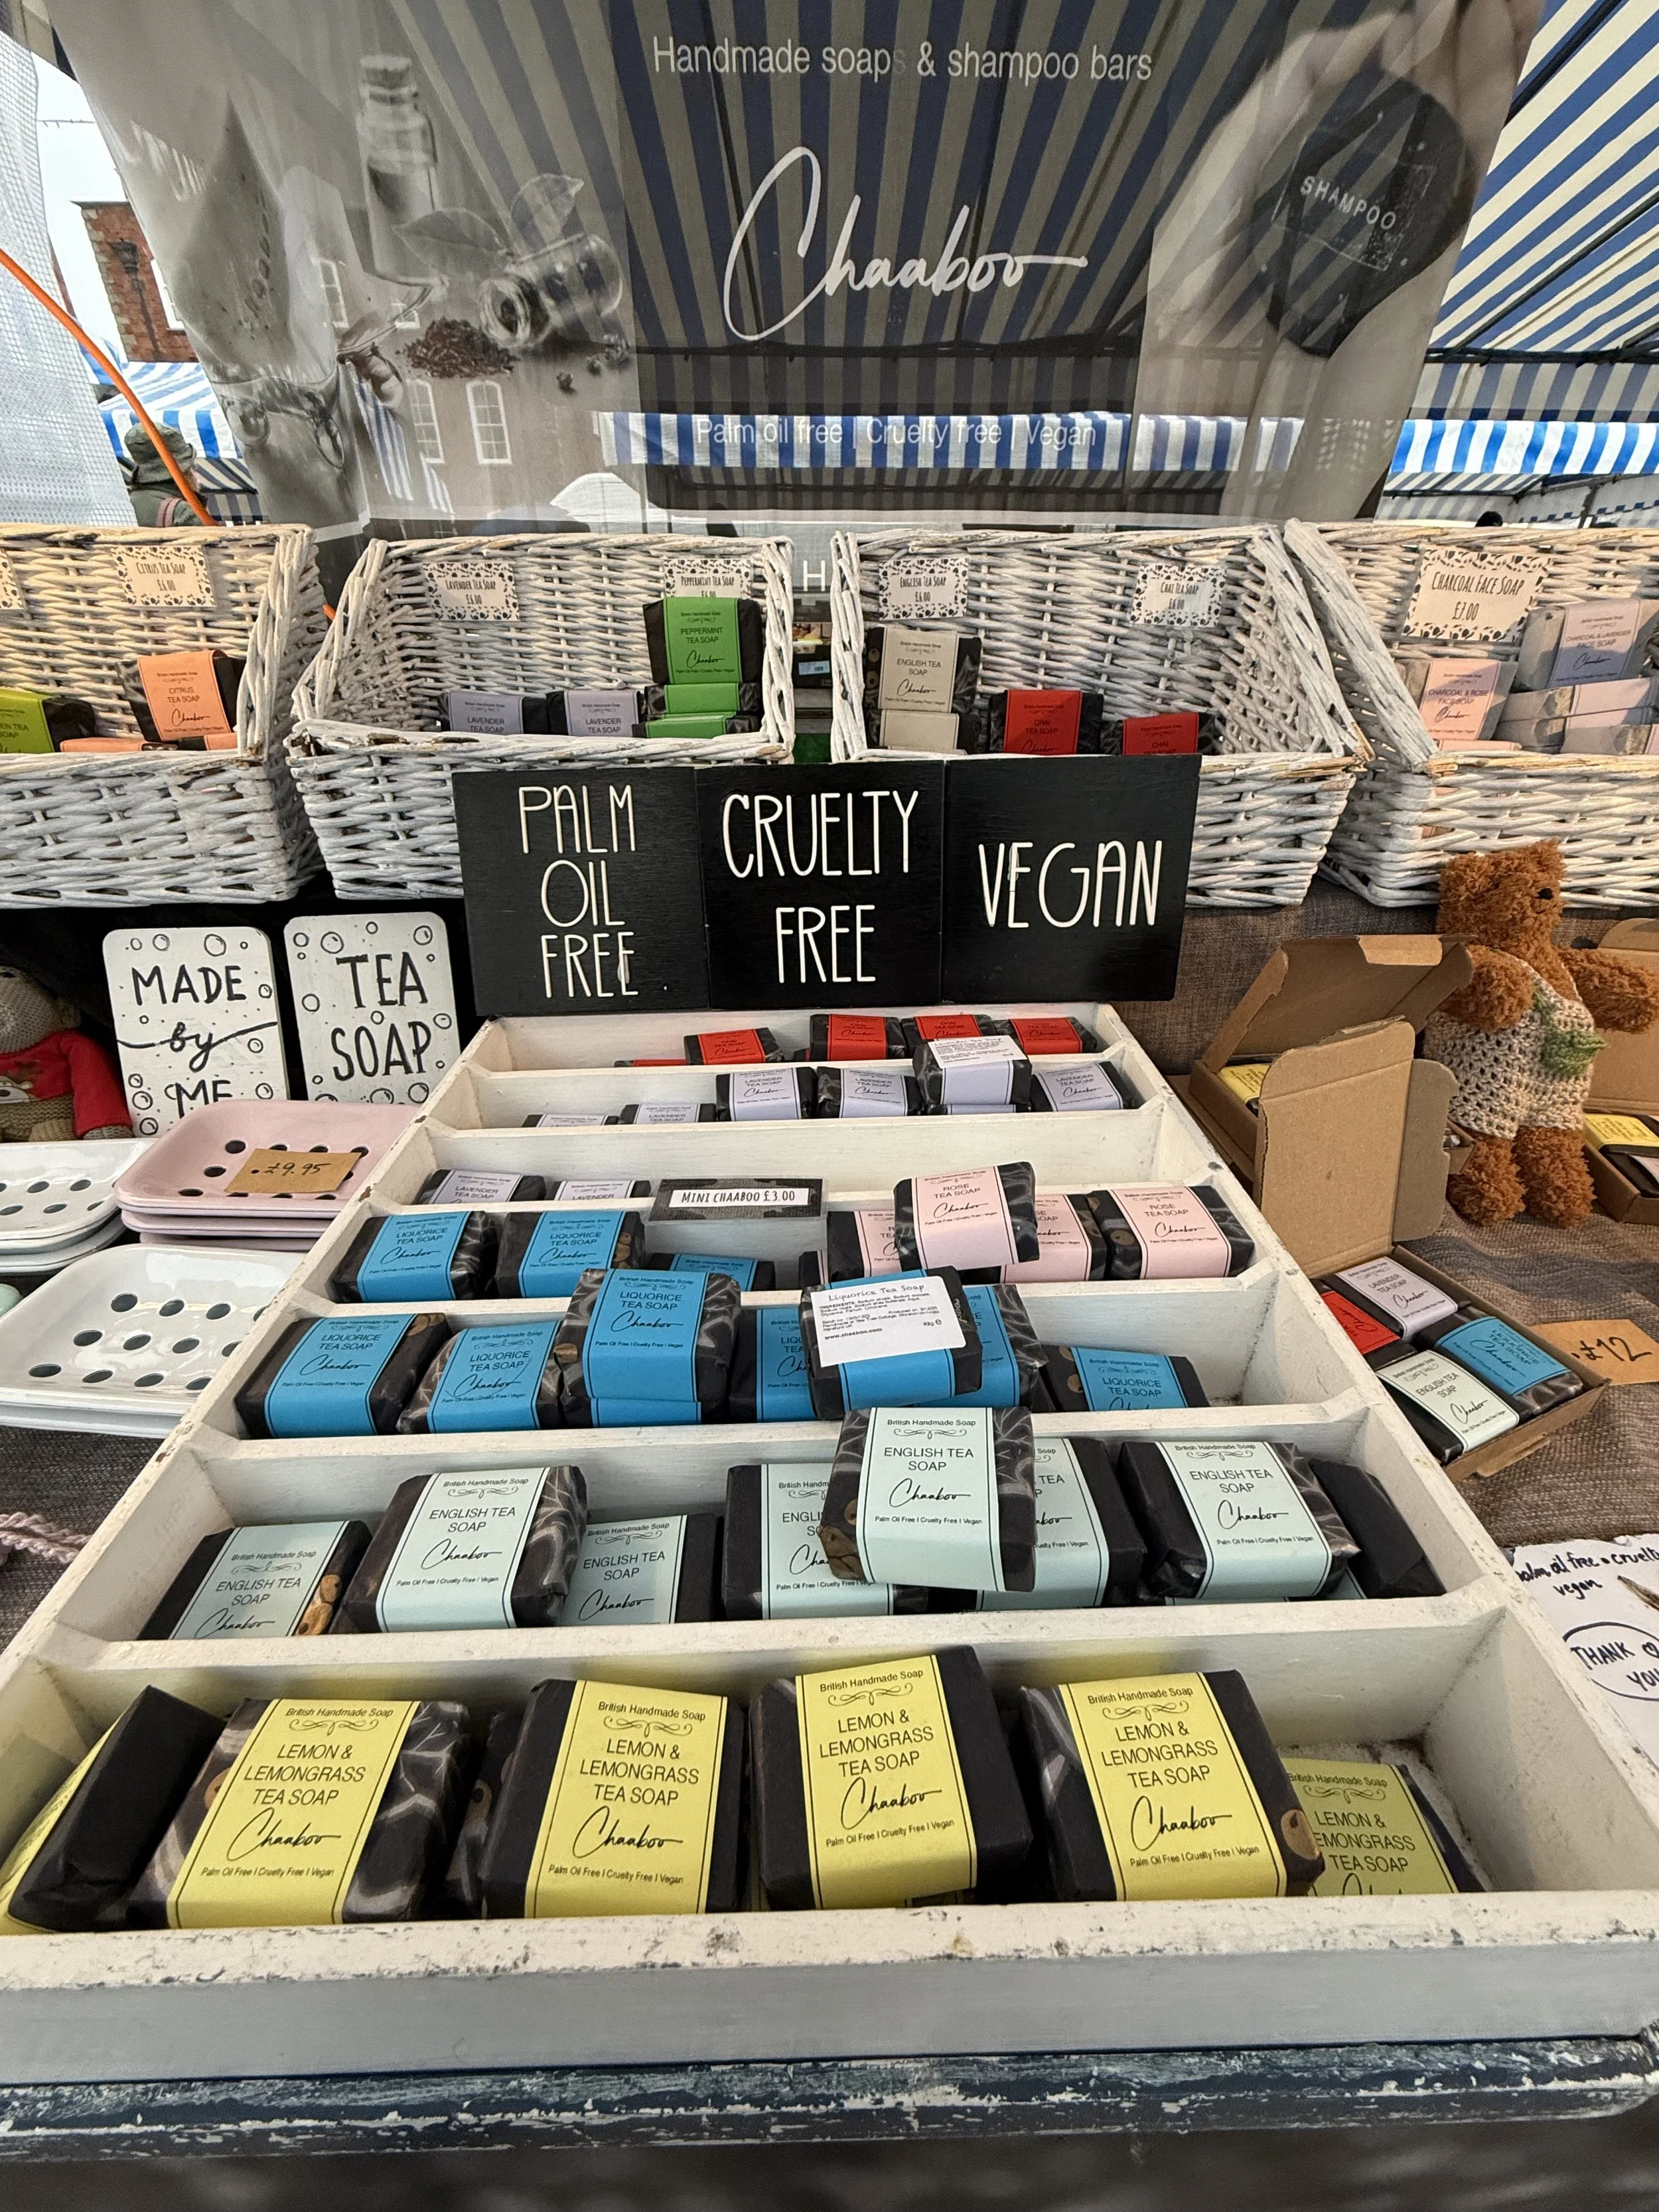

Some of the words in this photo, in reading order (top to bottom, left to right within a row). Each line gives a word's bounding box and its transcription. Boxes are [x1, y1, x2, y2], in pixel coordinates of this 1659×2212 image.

[653, 36, 810, 73] Handmade
[916, 41, 936, 77] &
[947, 41, 1079, 87] shampoo
[1090, 44, 1152, 80] bars
[1300, 175, 1396, 230] SHAMPOO
[723, 146, 1088, 341] Chaaboo
[697, 417, 755, 443] Palm
[763, 418, 788, 443] oil
[797, 417, 843, 443] free
[866, 418, 950, 449] Cruelty
[958, 419, 1002, 444] free
[1027, 419, 1096, 451] Vegan
[1452, 601, 1479, 621] £7.00
[897, 658, 927, 667] ENGLISH
[169, 686, 195, 695] CITRUS
[519, 784, 638, 854] PALM
[723, 790, 919, 879] CRUELTY
[540, 860, 626, 928] OIL
[977, 839, 1163, 928] VEGAN
[775, 904, 877, 984] FREE
[540, 931, 640, 999] FREE
[132, 964, 248, 1005] MADE
[336, 951, 429, 1009] TEA
[330, 1020, 433, 1081] SOAP
[264, 1162, 332, 1176] £9.95
[682, 1192, 710, 1203] MINI
[713, 1191, 760, 1203] CHAABOO
[762, 1190, 795, 1201] £3.00
[942, 1183, 970, 1192] ROSE
[954, 1187, 981, 1196] SOAP
[619, 1291, 683, 1301] LIQUORICE
[901, 1284, 925, 1294] Soap
[645, 1301, 678, 1310] SOAP
[611, 1310, 684, 1332] Chaaboo
[884, 1447, 943, 1457] ENGLISH
[946, 1448, 974, 1457] TEA
[908, 1461, 947, 1471] SOAP
[1189, 1469, 1246, 1480] ENGLISH
[1246, 1469, 1273, 1479] TEA
[889, 1477, 971, 1508] Chaaboo
[1219, 1483, 1254, 1493] SOAP
[429, 1508, 488, 1520] ENGLISH
[491, 1507, 516, 1517] TEA
[1218, 1499, 1289, 1530] Chaaboo
[447, 1522, 486, 1532] SOAP
[421, 1538, 502, 1570] Chaaboo
[1550, 1554, 1571, 1574] oil
[1567, 1552, 1600, 1569] free
[1553, 1580, 1603, 1600] vegan
[1570, 1641, 1635, 1670] THANK
[598, 1701, 626, 1713] British
[629, 1704, 679, 1718] Handmade
[682, 1709, 706, 1722] Soap
[837, 1711, 895, 1733] LEMON
[899, 1709, 910, 1723] &
[820, 1726, 934, 1759] LEMONGRASS
[1115, 1722, 1175, 1742] LEMON
[1178, 1721, 1190, 1736] &
[277, 1744, 340, 1759] LEMON
[340, 1744, 353, 1759] &
[606, 1738, 666, 1758] LEMON
[669, 1744, 680, 1759] &
[1102, 1739, 1218, 1767] LEMONGRASS
[244, 1765, 366, 1782] LEMONGRASS
[579, 1759, 699, 1785] LEMONGRASS
[838, 1759, 872, 1777] TEA
[875, 1750, 920, 1772] SOAP
[1127, 1770, 1163, 1789] TEA
[1165, 1765, 1210, 1785] SOAP
[253, 1789, 285, 1805] TEA
[288, 1789, 340, 1805] SOAP
[594, 1783, 626, 1802] TEA
[630, 1786, 679, 1806] SOAP
[840, 1777, 943, 1830] Chaaboo
[226, 1806, 342, 1862] Chaaboo
[572, 1805, 684, 1859] Chaaboo
[1131, 1795, 1233, 1851] Chaaboo
[549, 1864, 567, 1875] Palm
[569, 1866, 581, 1876] Oil
[582, 1866, 601, 1878] Free
[606, 1870, 634, 1883] Cruelty
[635, 1871, 653, 1882] Free
[660, 1873, 684, 1885] Vegan
